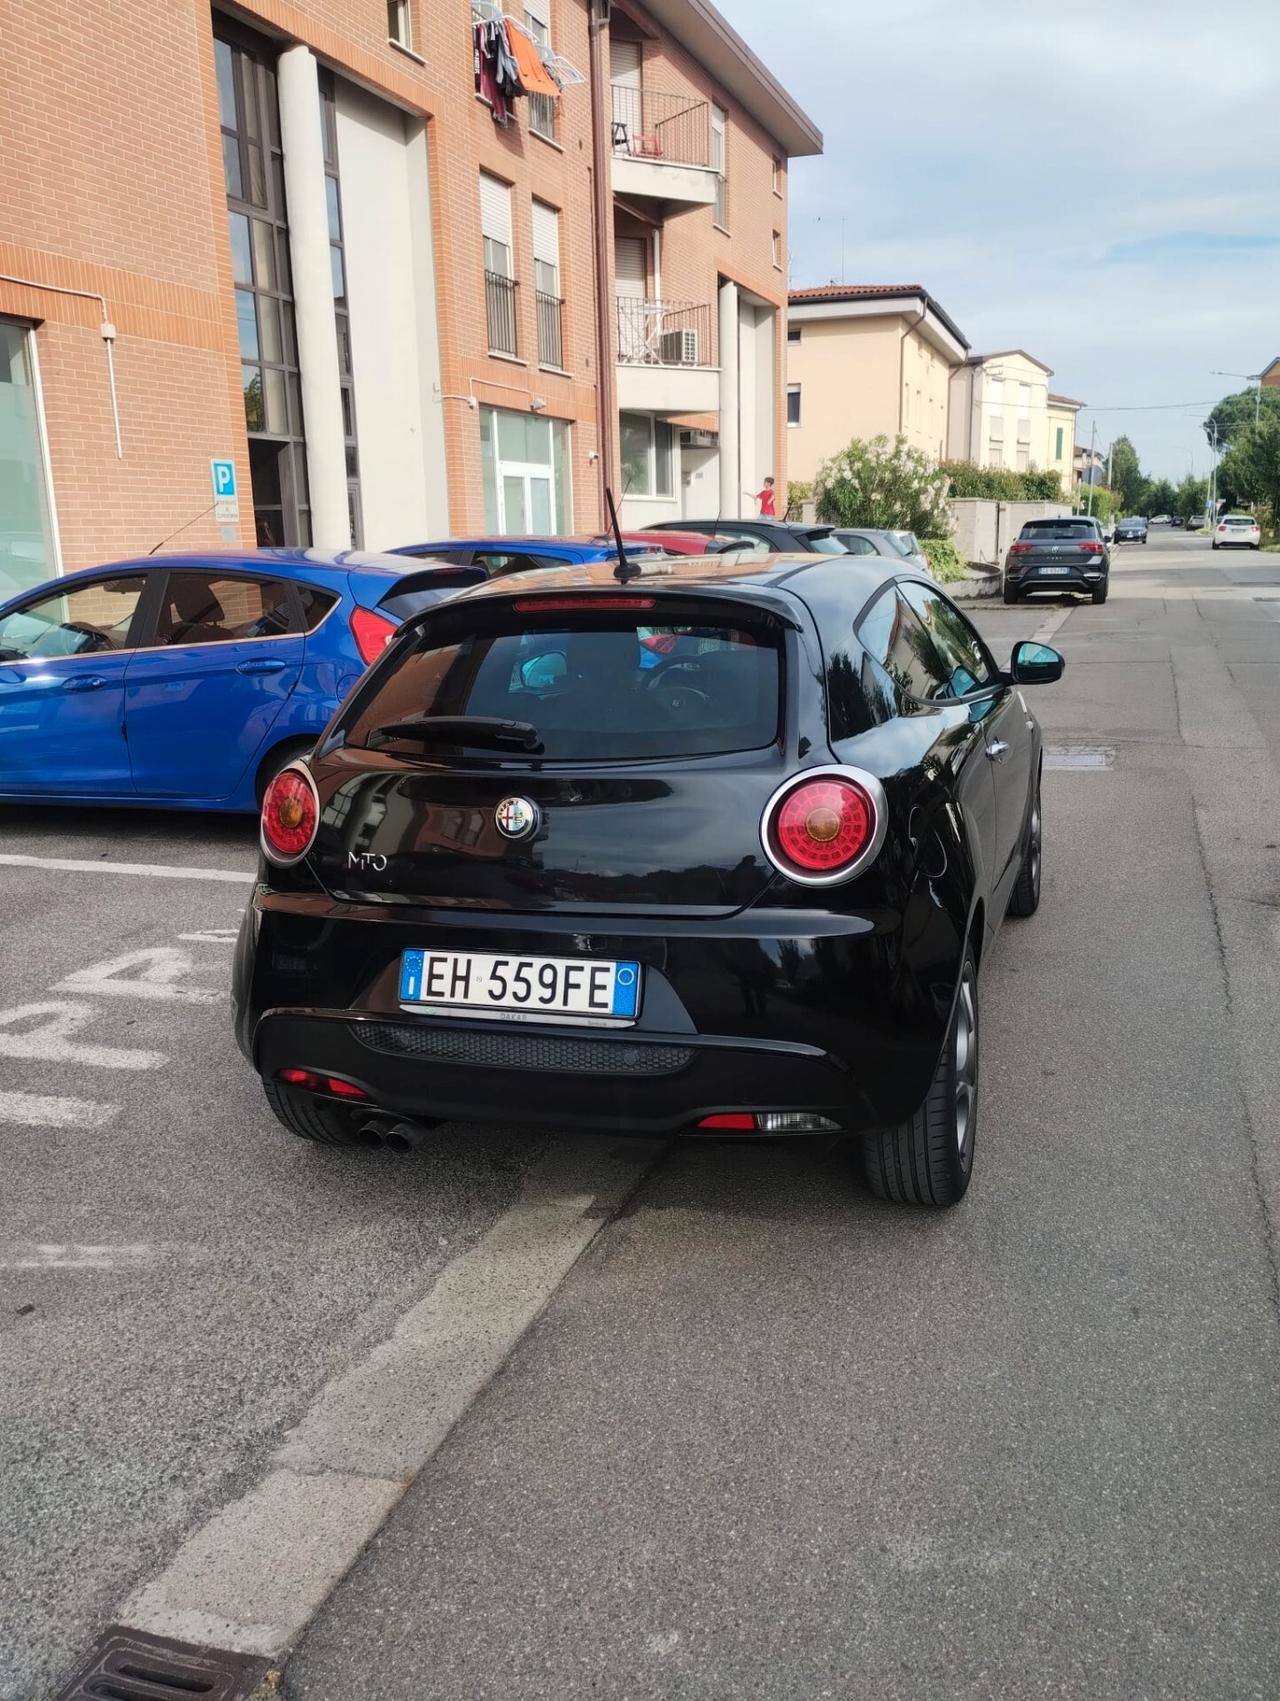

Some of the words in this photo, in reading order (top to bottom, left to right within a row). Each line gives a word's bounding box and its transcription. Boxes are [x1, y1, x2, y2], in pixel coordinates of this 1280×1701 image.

[216, 466, 231, 493] P
[426, 956, 472, 999] EH
[488, 960, 611, 1009] 559FE
